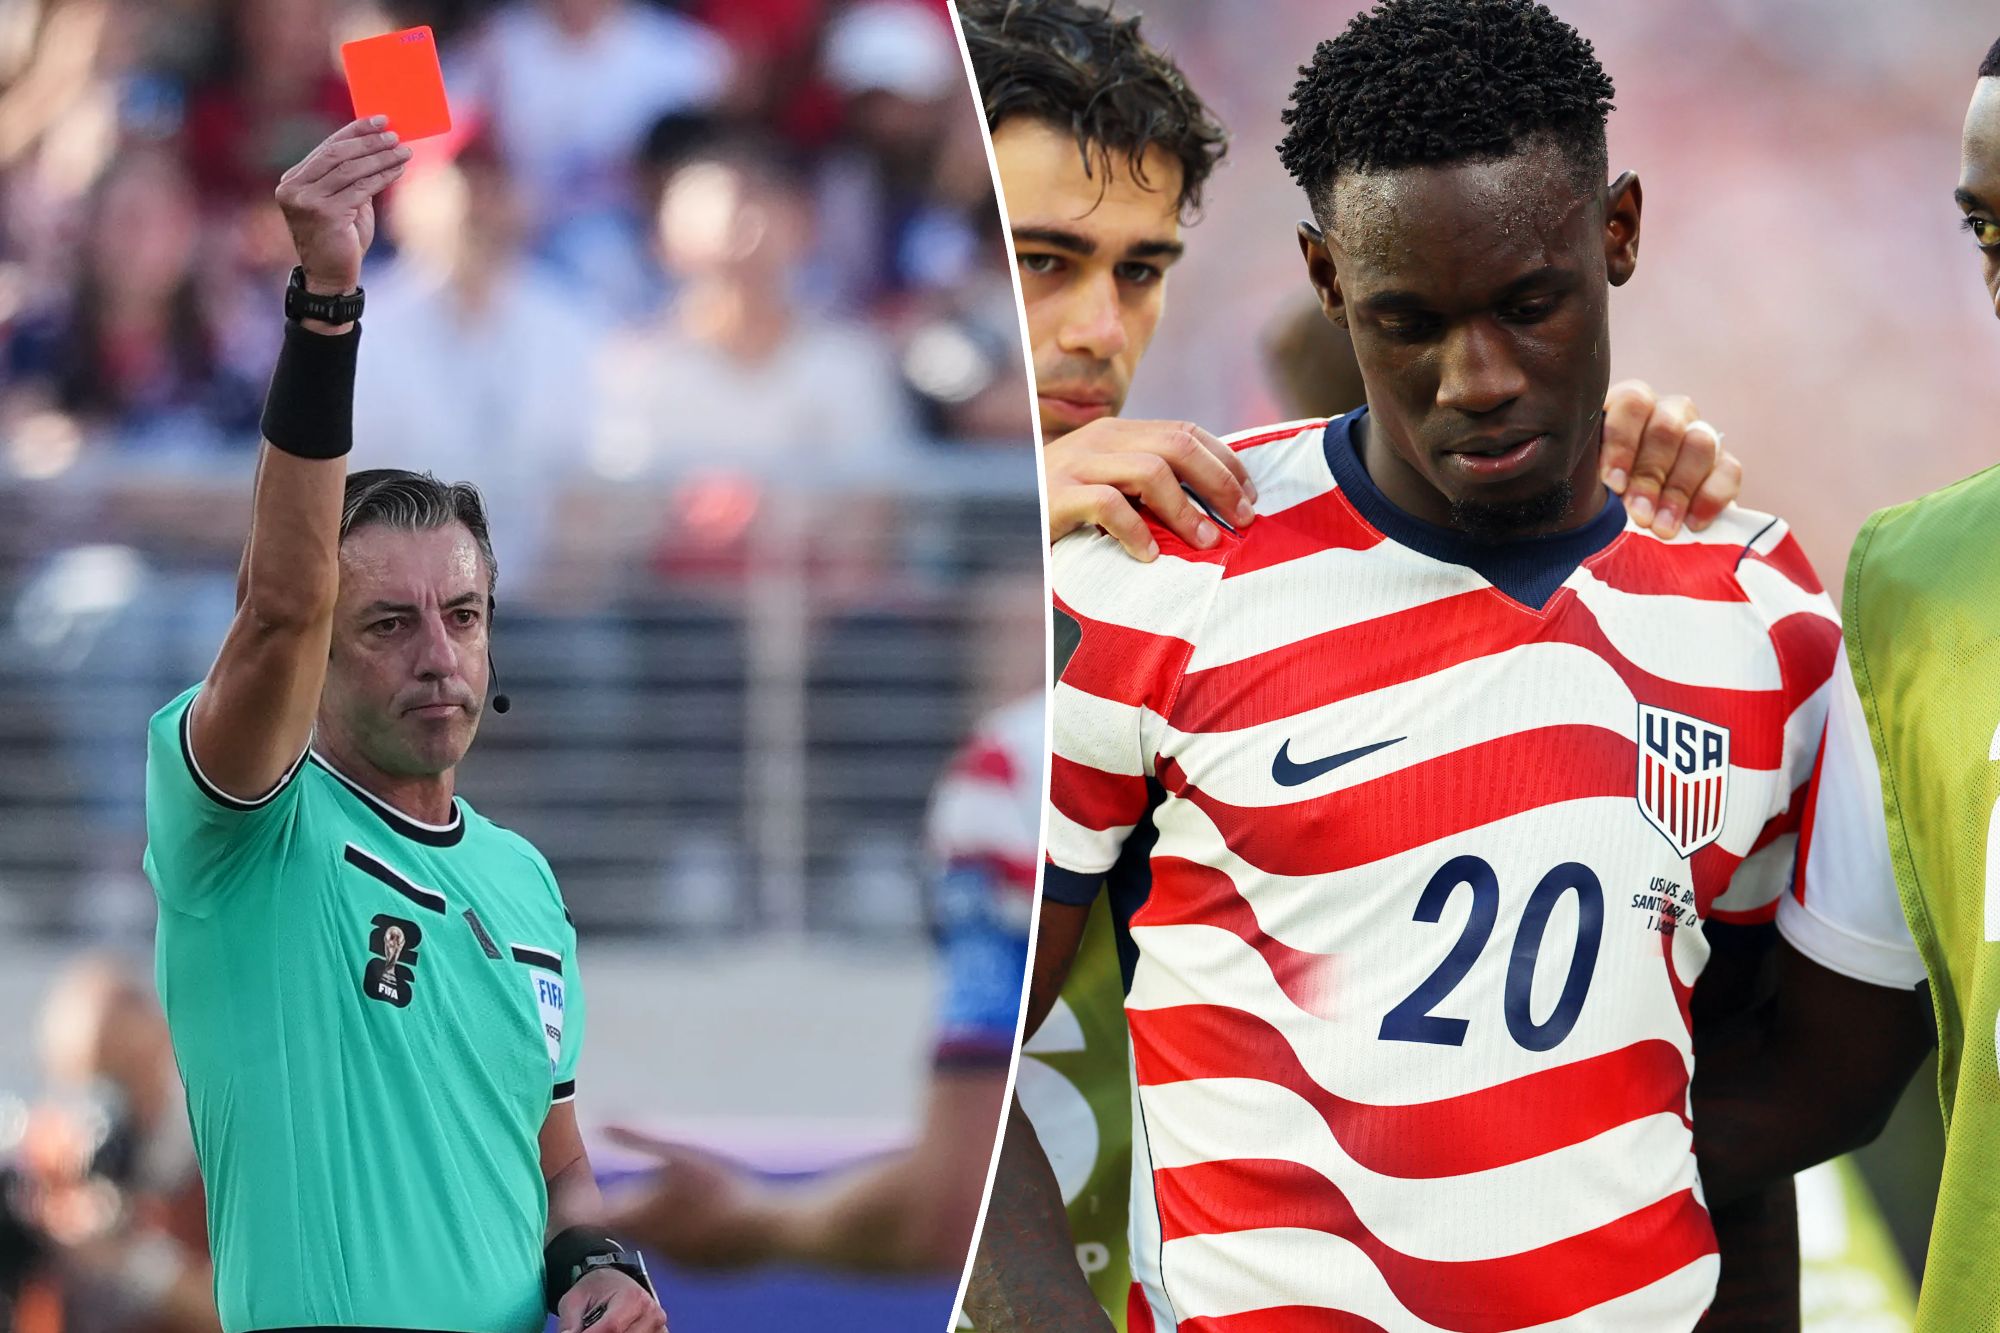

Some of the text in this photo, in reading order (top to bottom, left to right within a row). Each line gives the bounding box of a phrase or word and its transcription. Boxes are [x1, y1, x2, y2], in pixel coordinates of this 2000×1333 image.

[1646, 713, 1722, 775] USA
[1377, 854, 1604, 1052] 20
[378, 982, 399, 1000] FIFA
[537, 978, 565, 1014] FIFA
